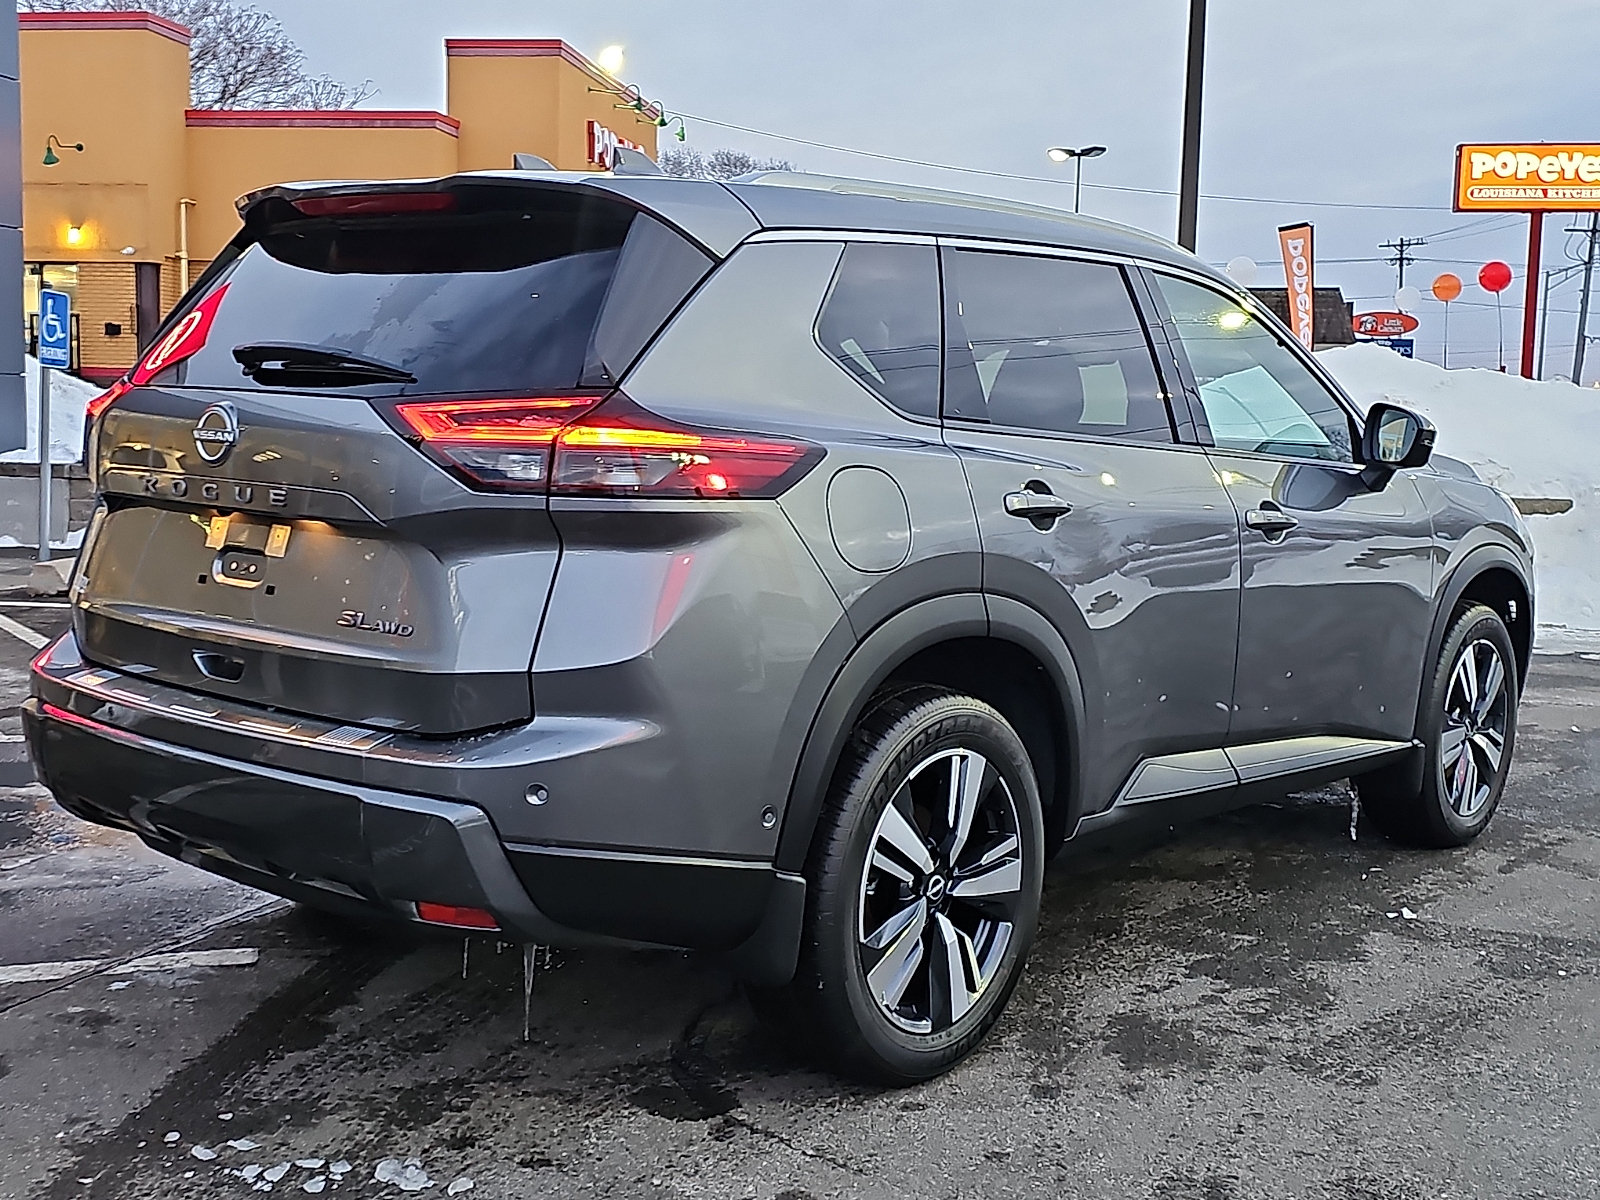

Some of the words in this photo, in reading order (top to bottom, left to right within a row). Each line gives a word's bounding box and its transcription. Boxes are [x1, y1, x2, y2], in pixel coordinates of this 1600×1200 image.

[1470, 150, 1600, 182] POPeYe
[1473, 188, 1543, 198] LOUISIANA
[193, 429, 235, 442] NISSAN
[143, 476, 288, 507] ROGUE
